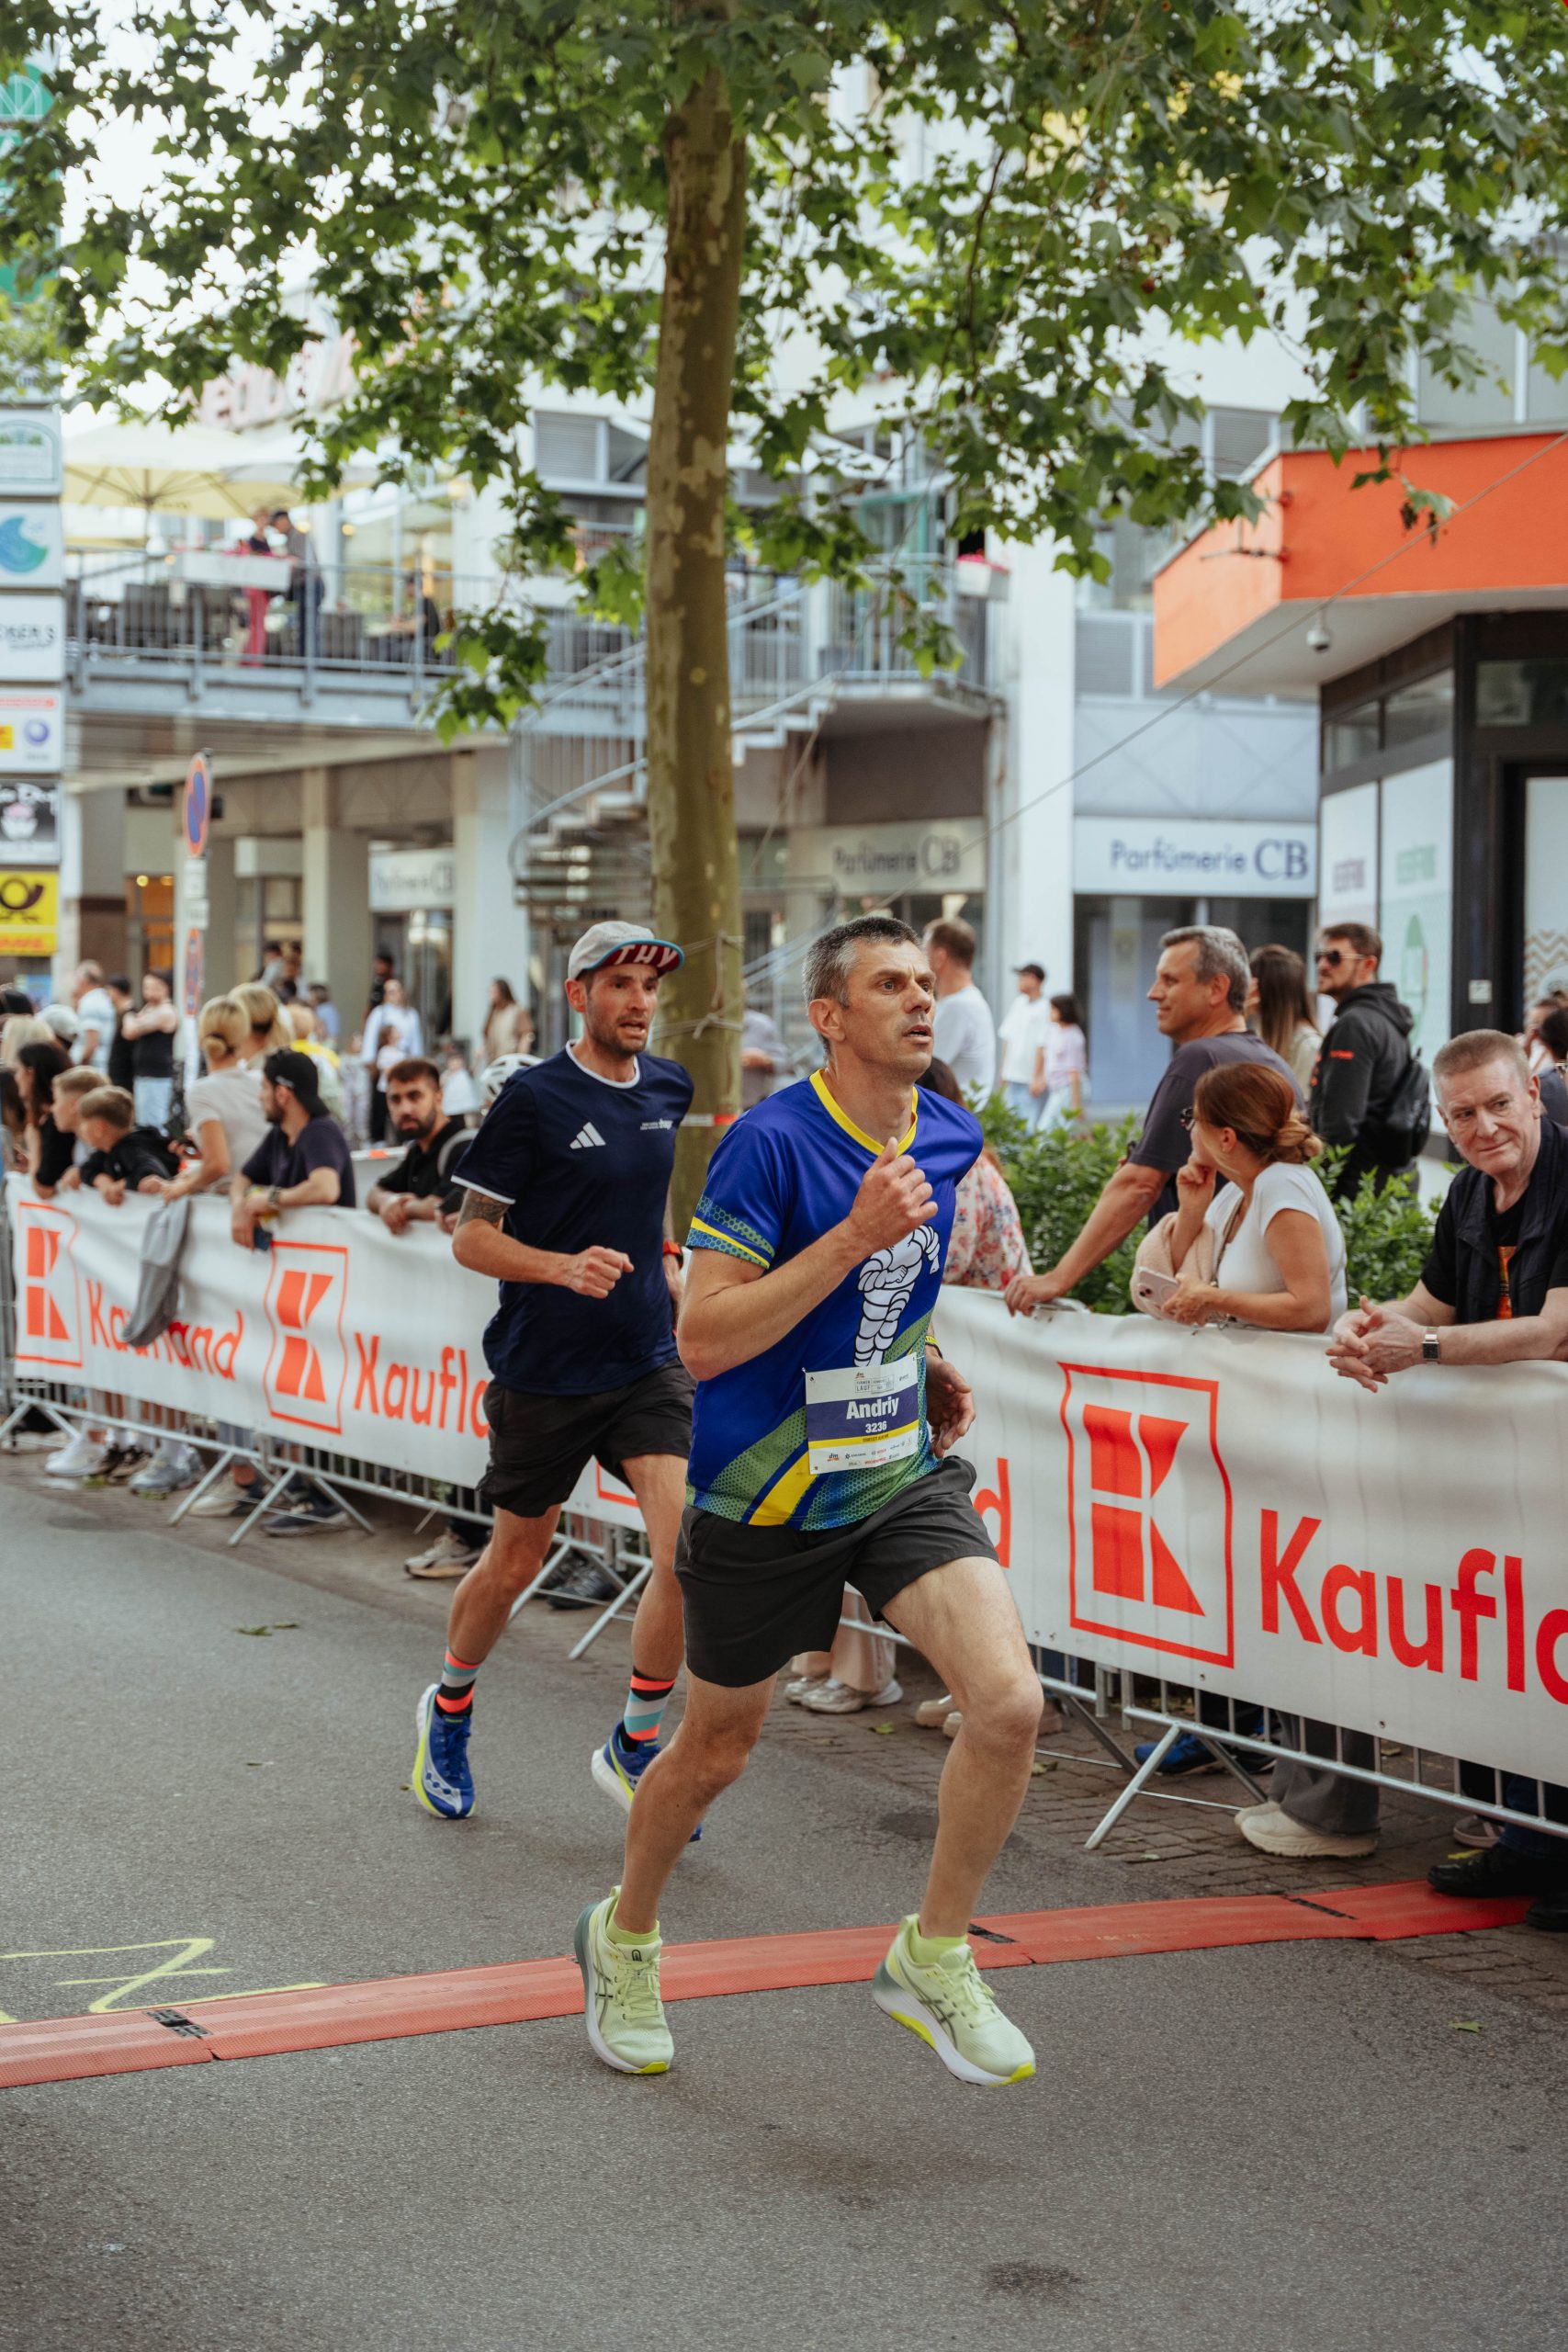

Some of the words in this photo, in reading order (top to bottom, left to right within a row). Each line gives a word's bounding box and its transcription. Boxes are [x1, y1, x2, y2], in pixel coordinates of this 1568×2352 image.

[921, 835, 962, 877] CB
[1111, 836, 1247, 874] Parfümerie
[1254, 837, 1309, 881] CB
[846, 1396, 899, 1419] Andriy
[865, 1420, 887, 1434] 3236
